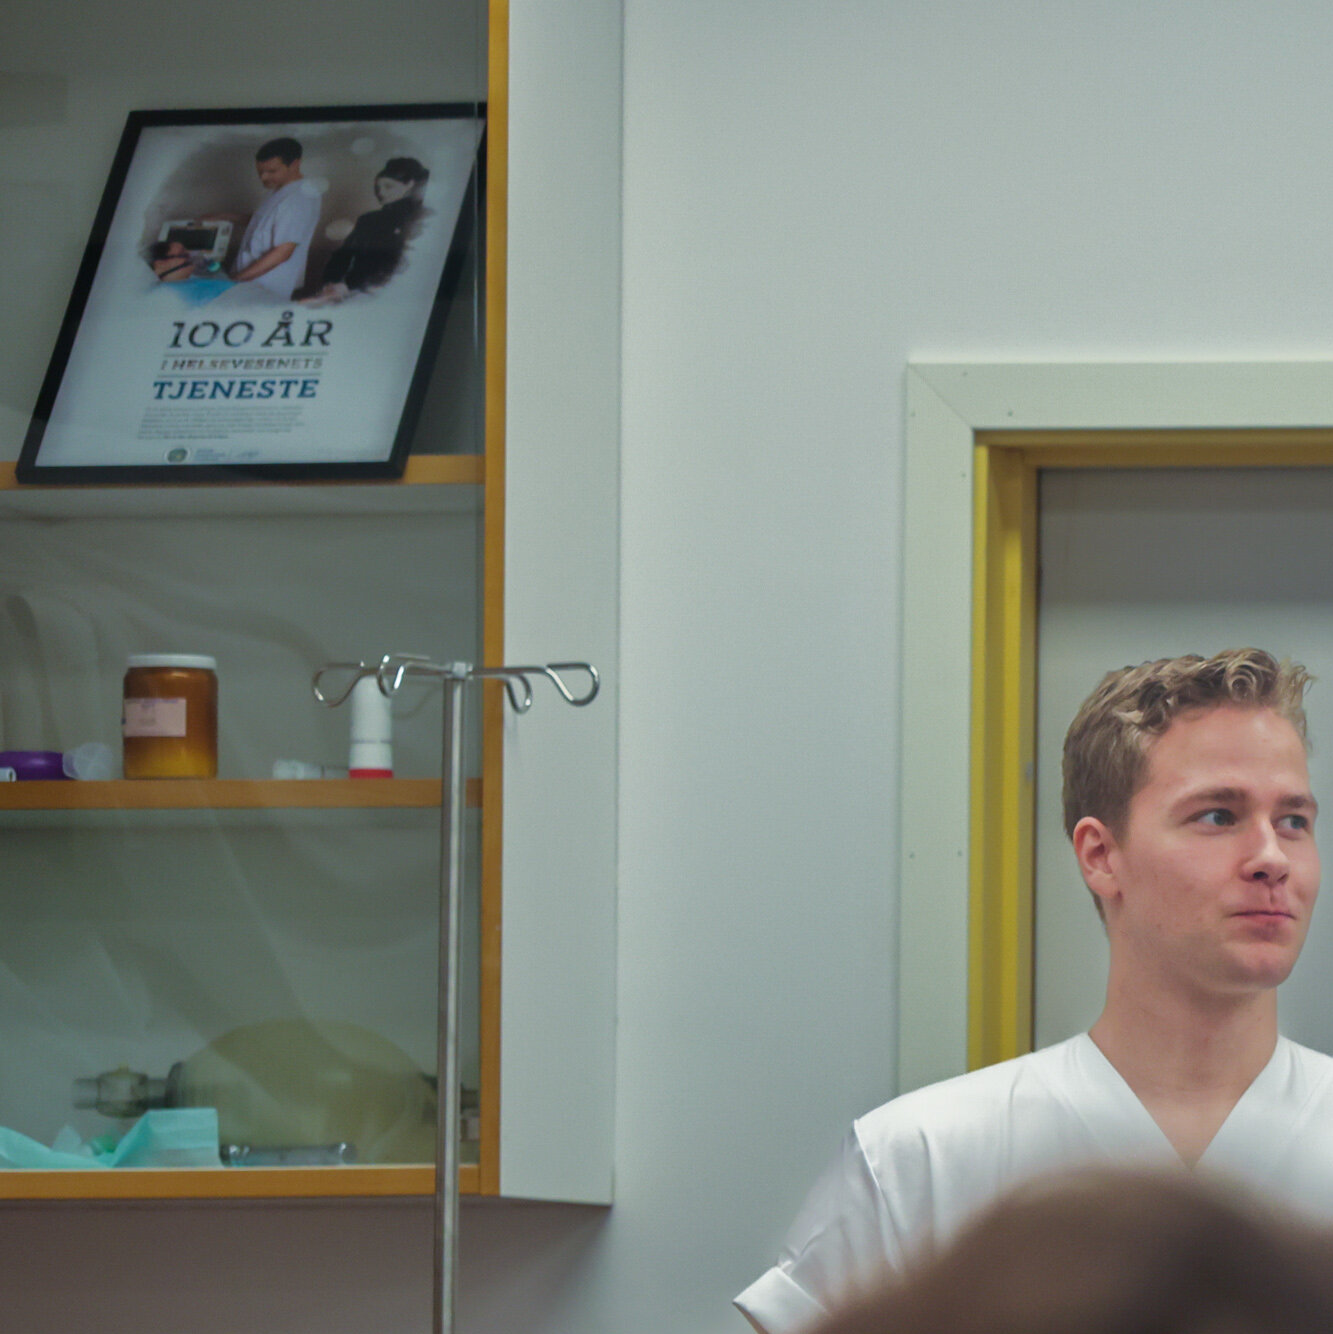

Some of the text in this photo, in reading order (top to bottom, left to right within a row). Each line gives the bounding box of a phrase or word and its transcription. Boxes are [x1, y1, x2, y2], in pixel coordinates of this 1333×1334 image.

[169, 310, 333, 348] 100 ÅR
[171, 357, 324, 371] HELSEVESENETS
[153, 379, 320, 400] TJENESTE
